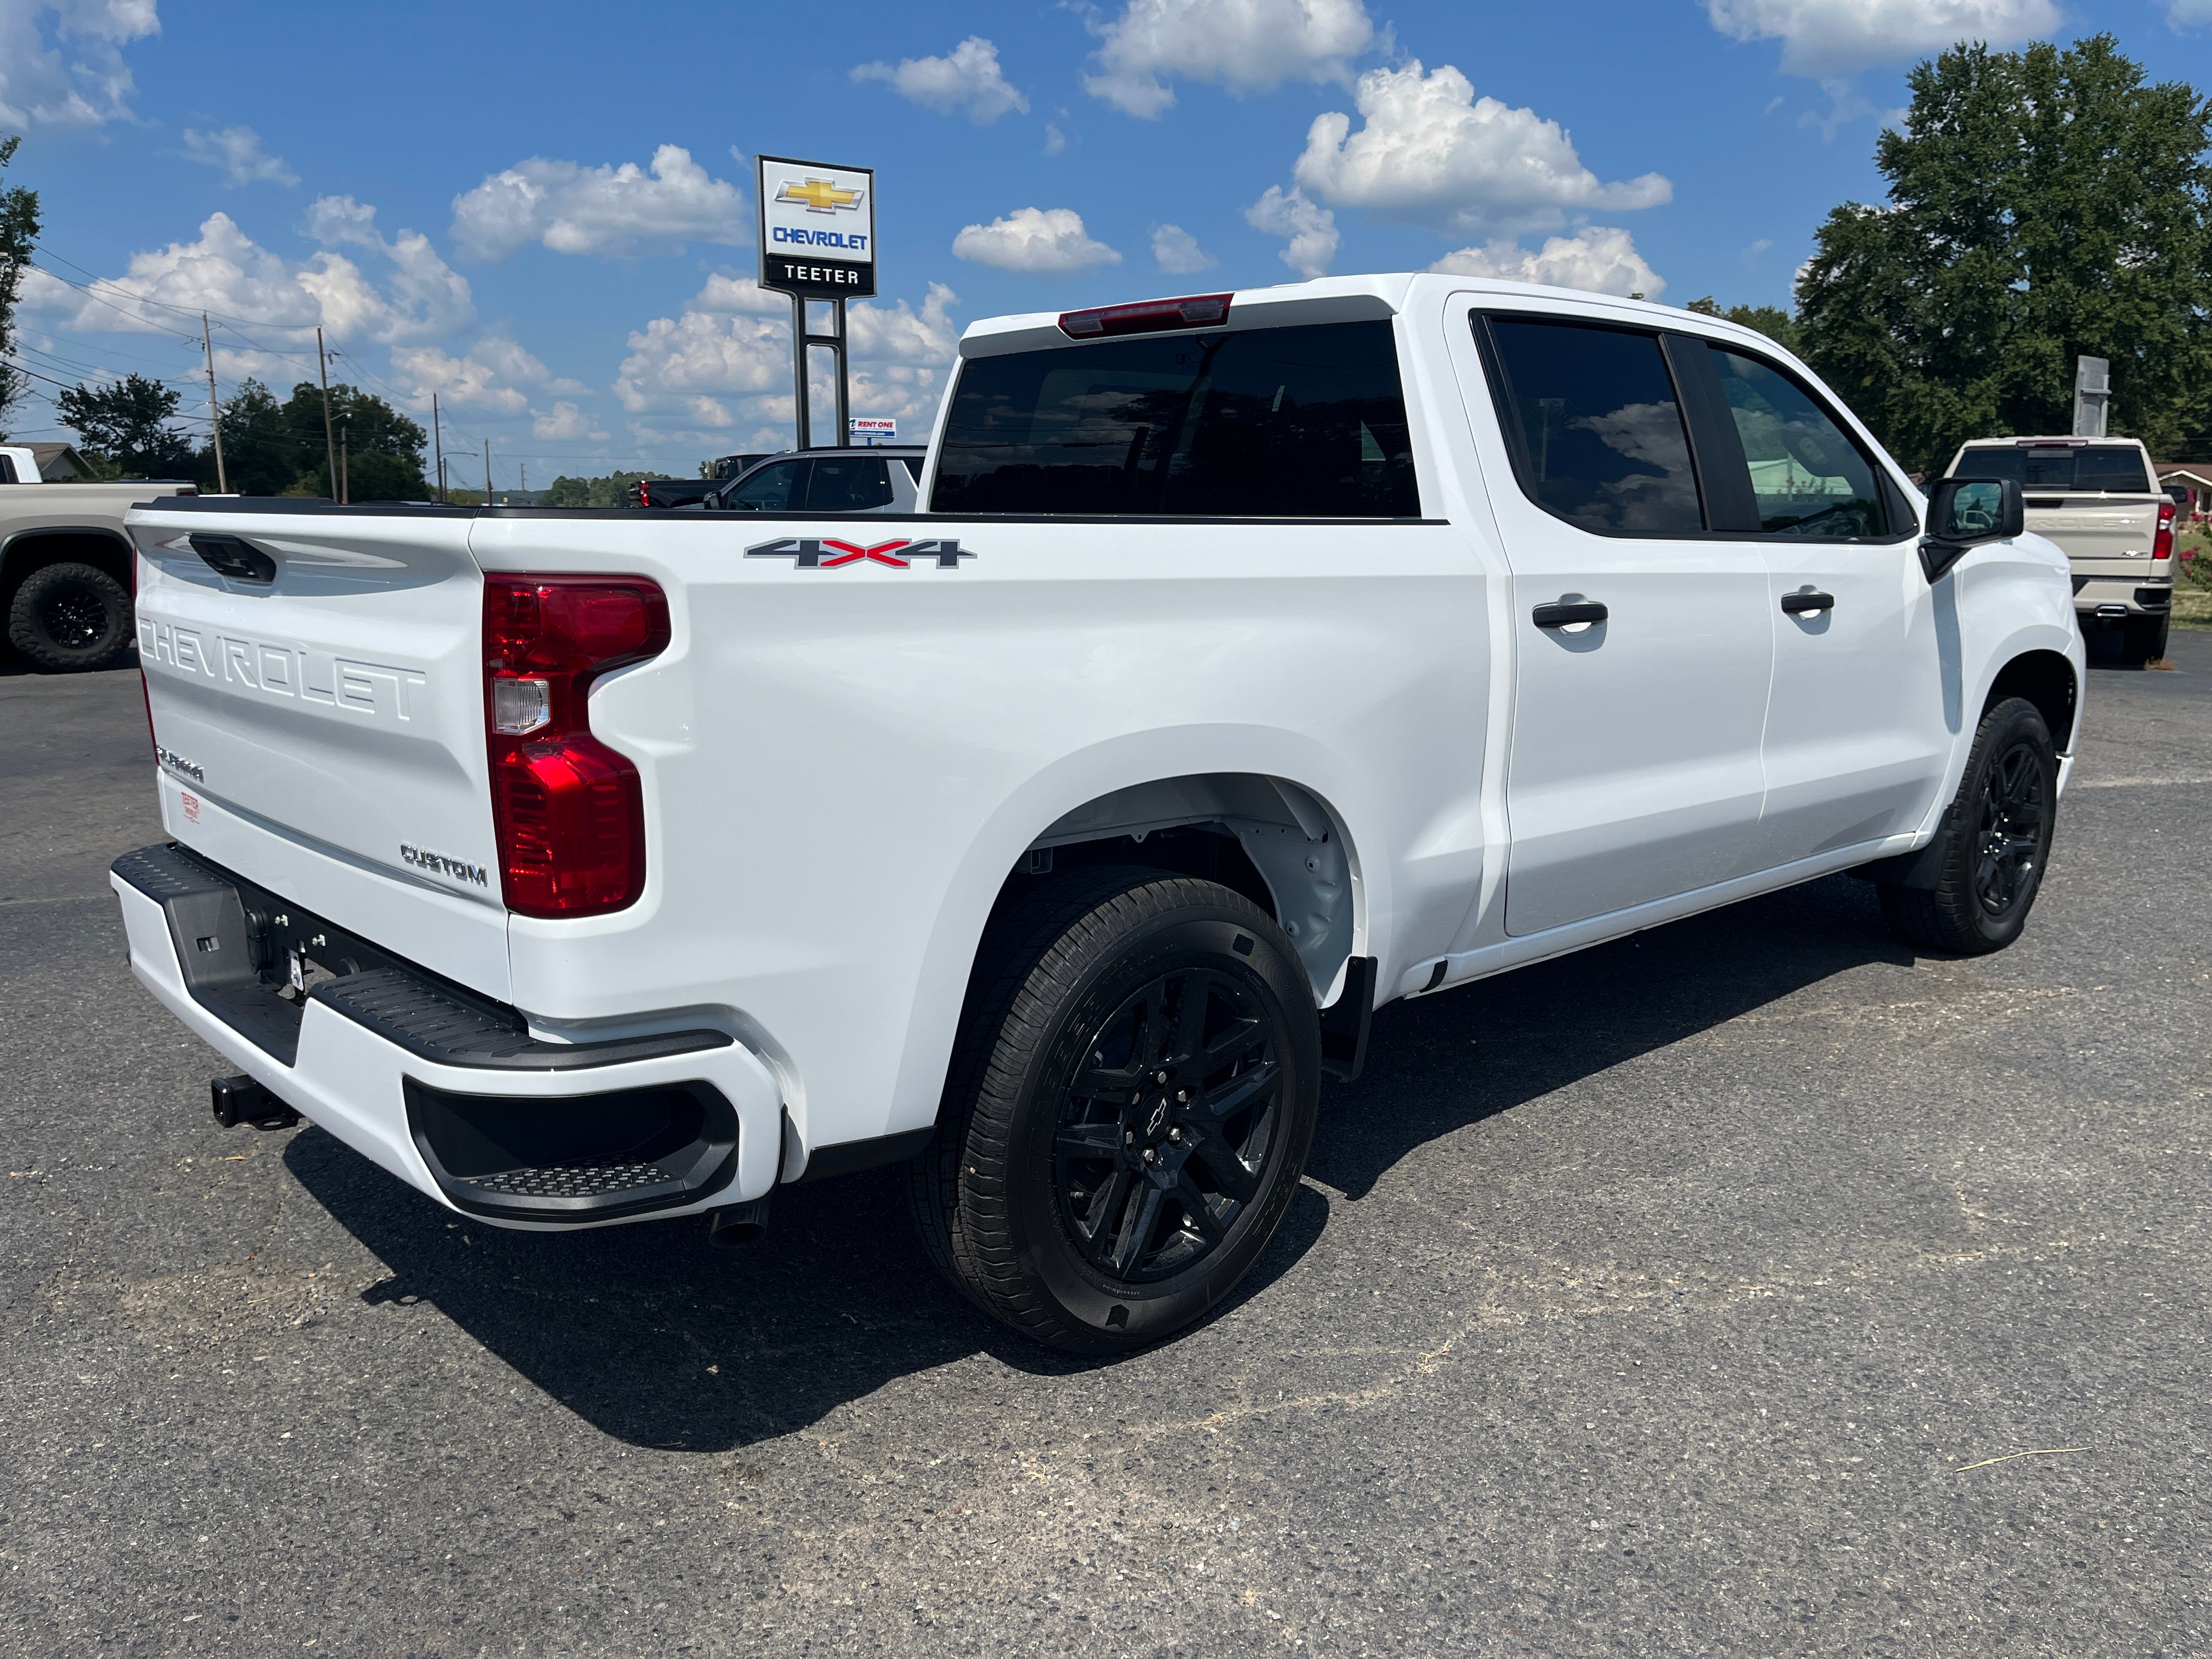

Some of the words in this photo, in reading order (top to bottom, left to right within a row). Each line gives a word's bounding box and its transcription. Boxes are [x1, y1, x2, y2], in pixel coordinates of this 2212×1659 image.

[774, 227, 867, 250] CHEVROLET
[785, 265, 859, 284] TEETER
[137, 616, 426, 721] CHEVROLET
[400, 843, 488, 888] CUSTOM
